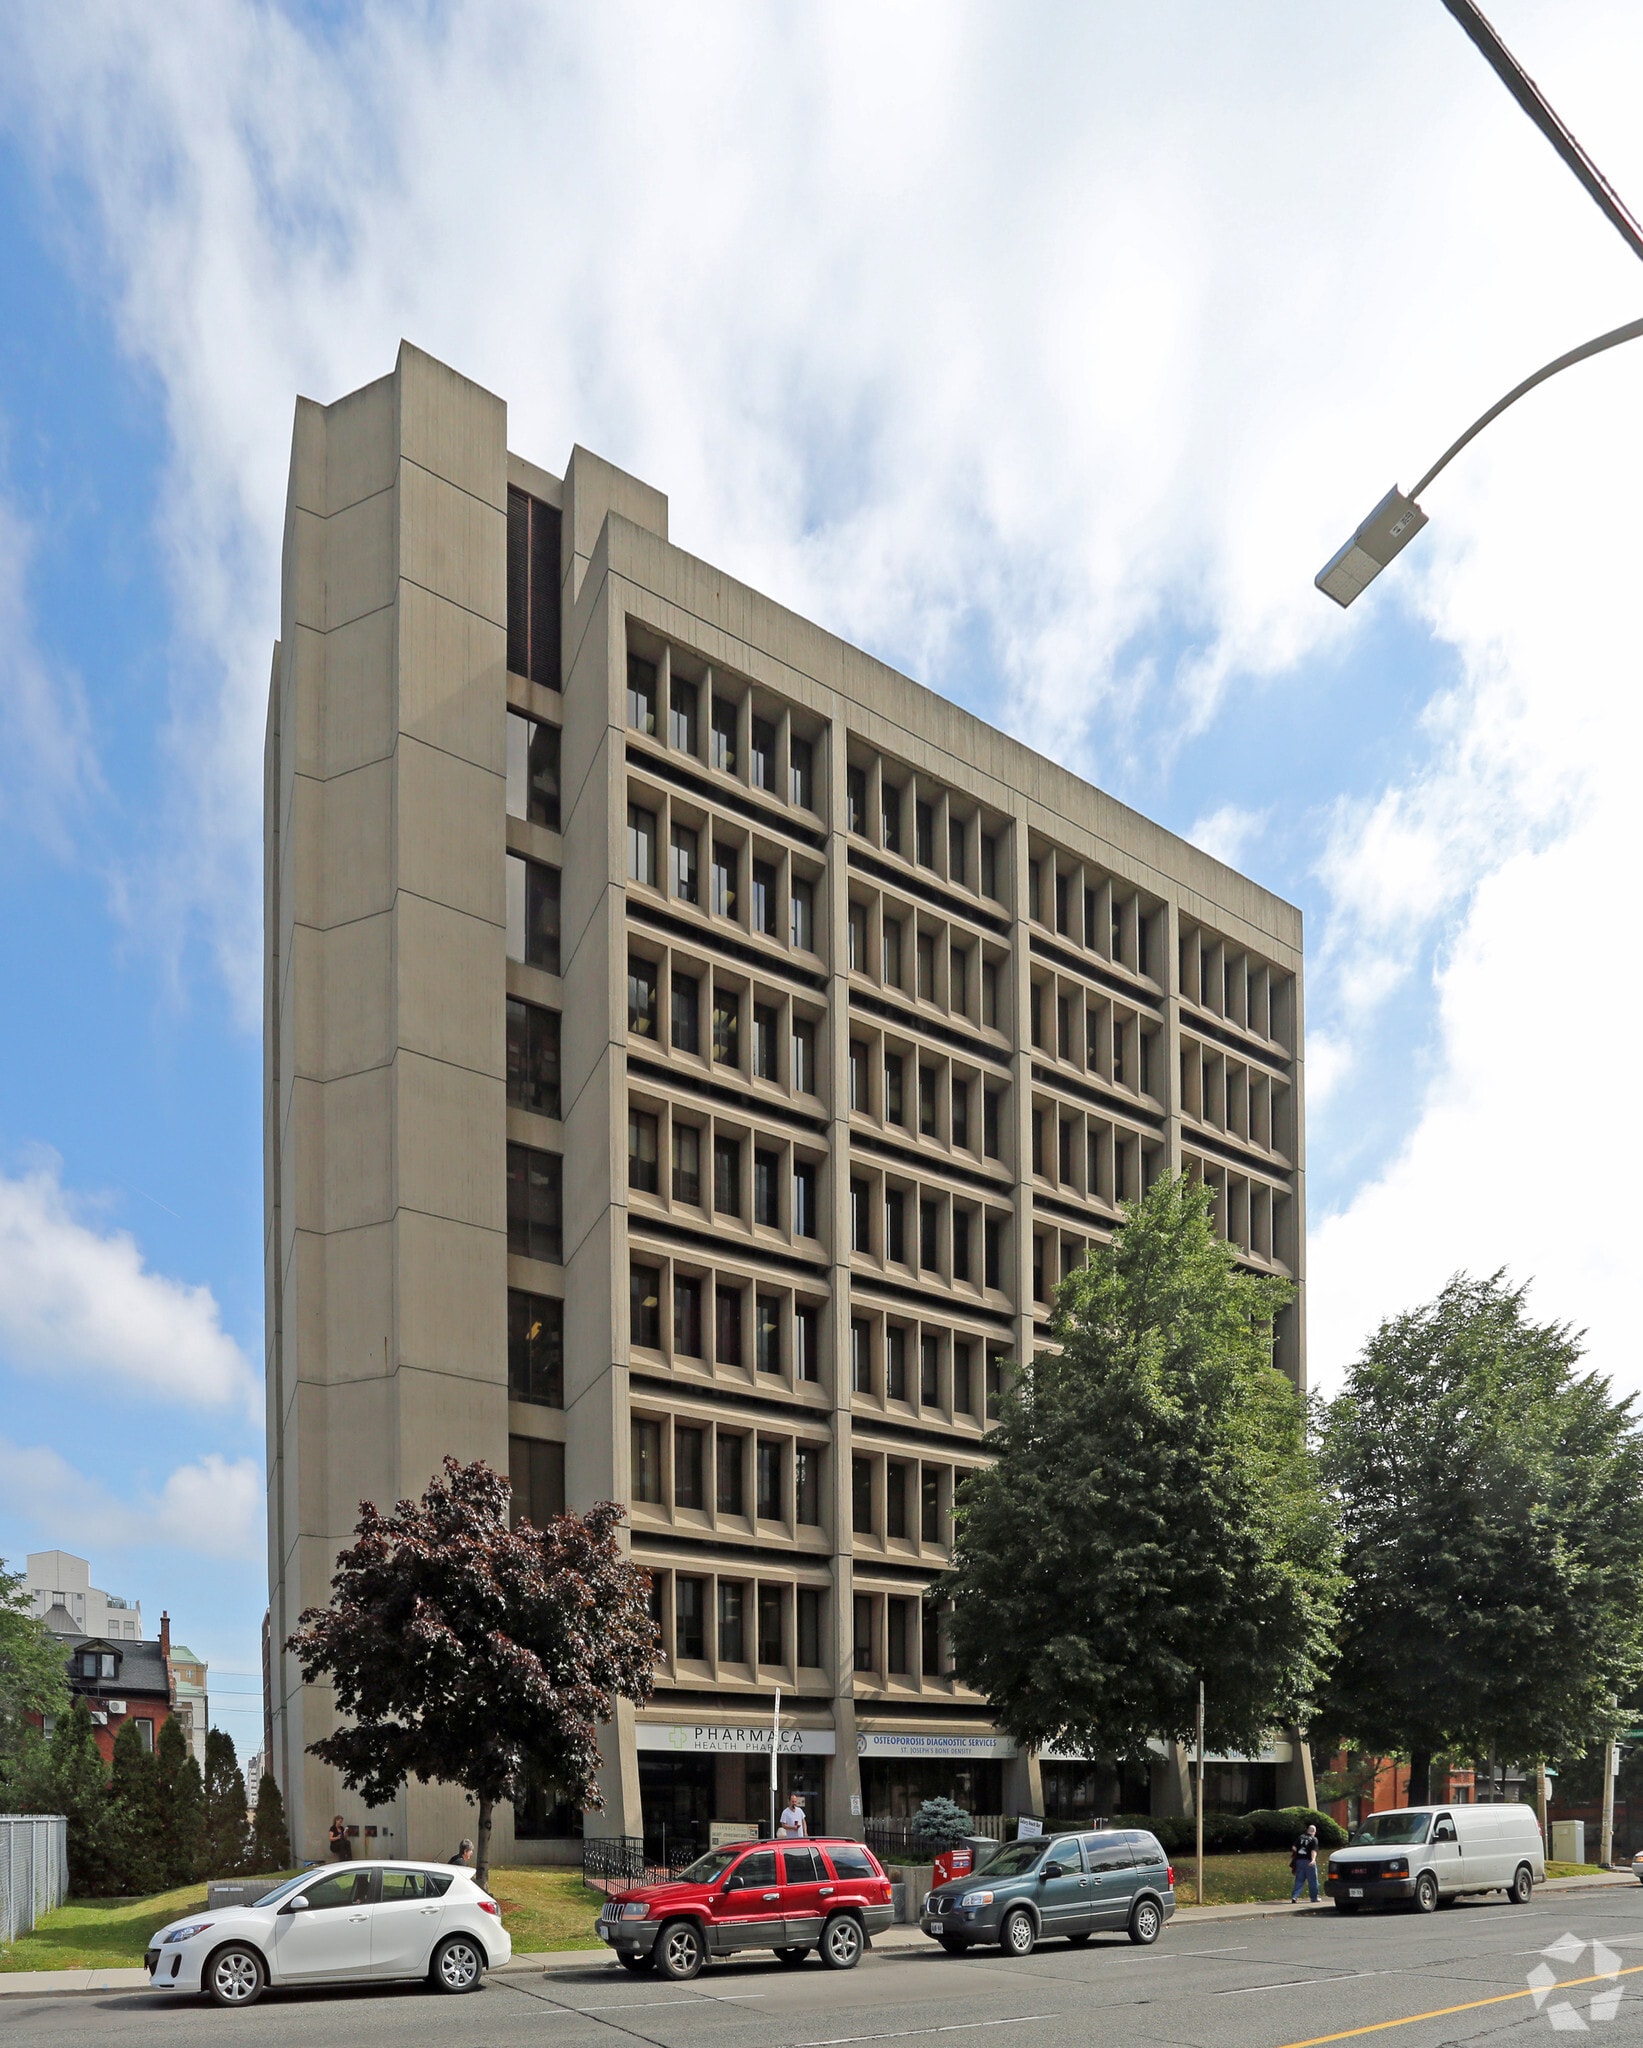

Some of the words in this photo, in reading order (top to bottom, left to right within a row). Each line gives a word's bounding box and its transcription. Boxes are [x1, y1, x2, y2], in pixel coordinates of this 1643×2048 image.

[694, 1727, 803, 1743] PHARMACA
[694, 1742, 737, 1751] HEALTH
[873, 1736, 925, 1746] OSTEOPOROSIS
[926, 1738, 967, 1747] DIAGNOSTIC
[968, 1738, 997, 1747] SERVICES
